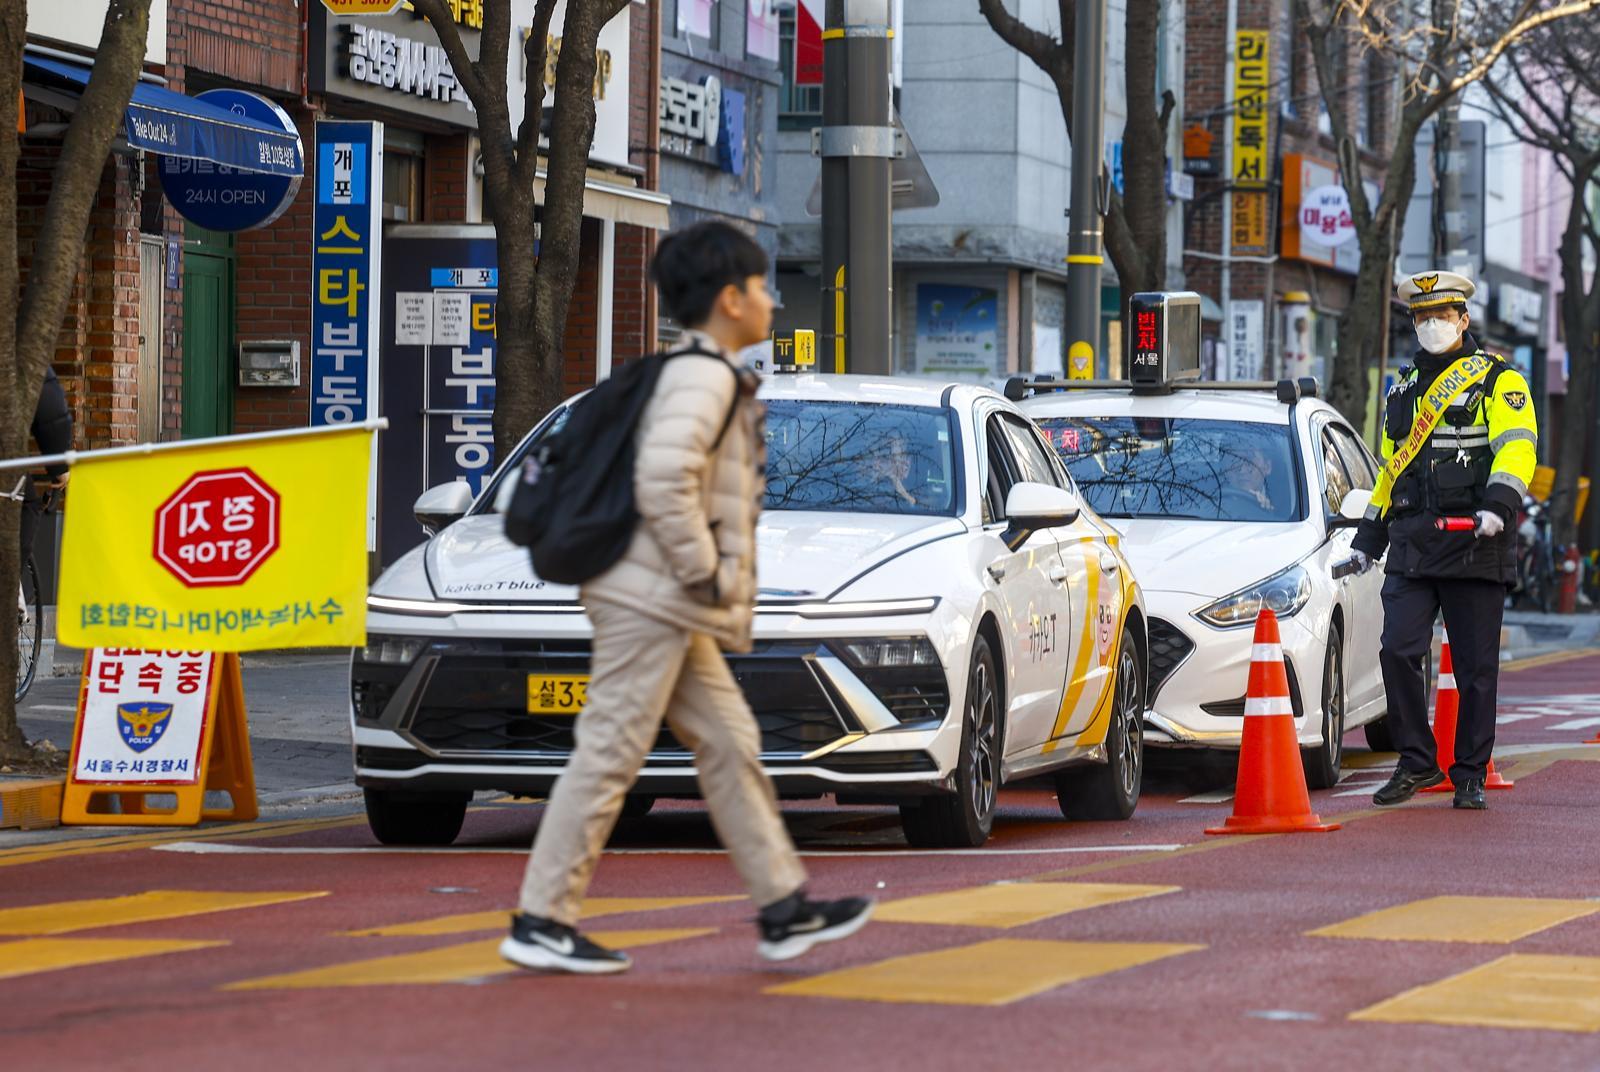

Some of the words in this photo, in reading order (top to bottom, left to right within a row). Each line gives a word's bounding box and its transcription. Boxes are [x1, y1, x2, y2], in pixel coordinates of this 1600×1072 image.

[131, 117, 148, 139] Take
[185, 189, 217, 204] 24시
[220, 189, 266, 204] OPEN
[1138, 311, 1157, 350] 빈차
[1134, 353, 1159, 366] 서울
[444, 583, 493, 594] kakao
[508, 580, 546, 590] blue
[128, 736, 154, 745] POLICE
[83, 759, 189, 774] 서울수서경찰서
